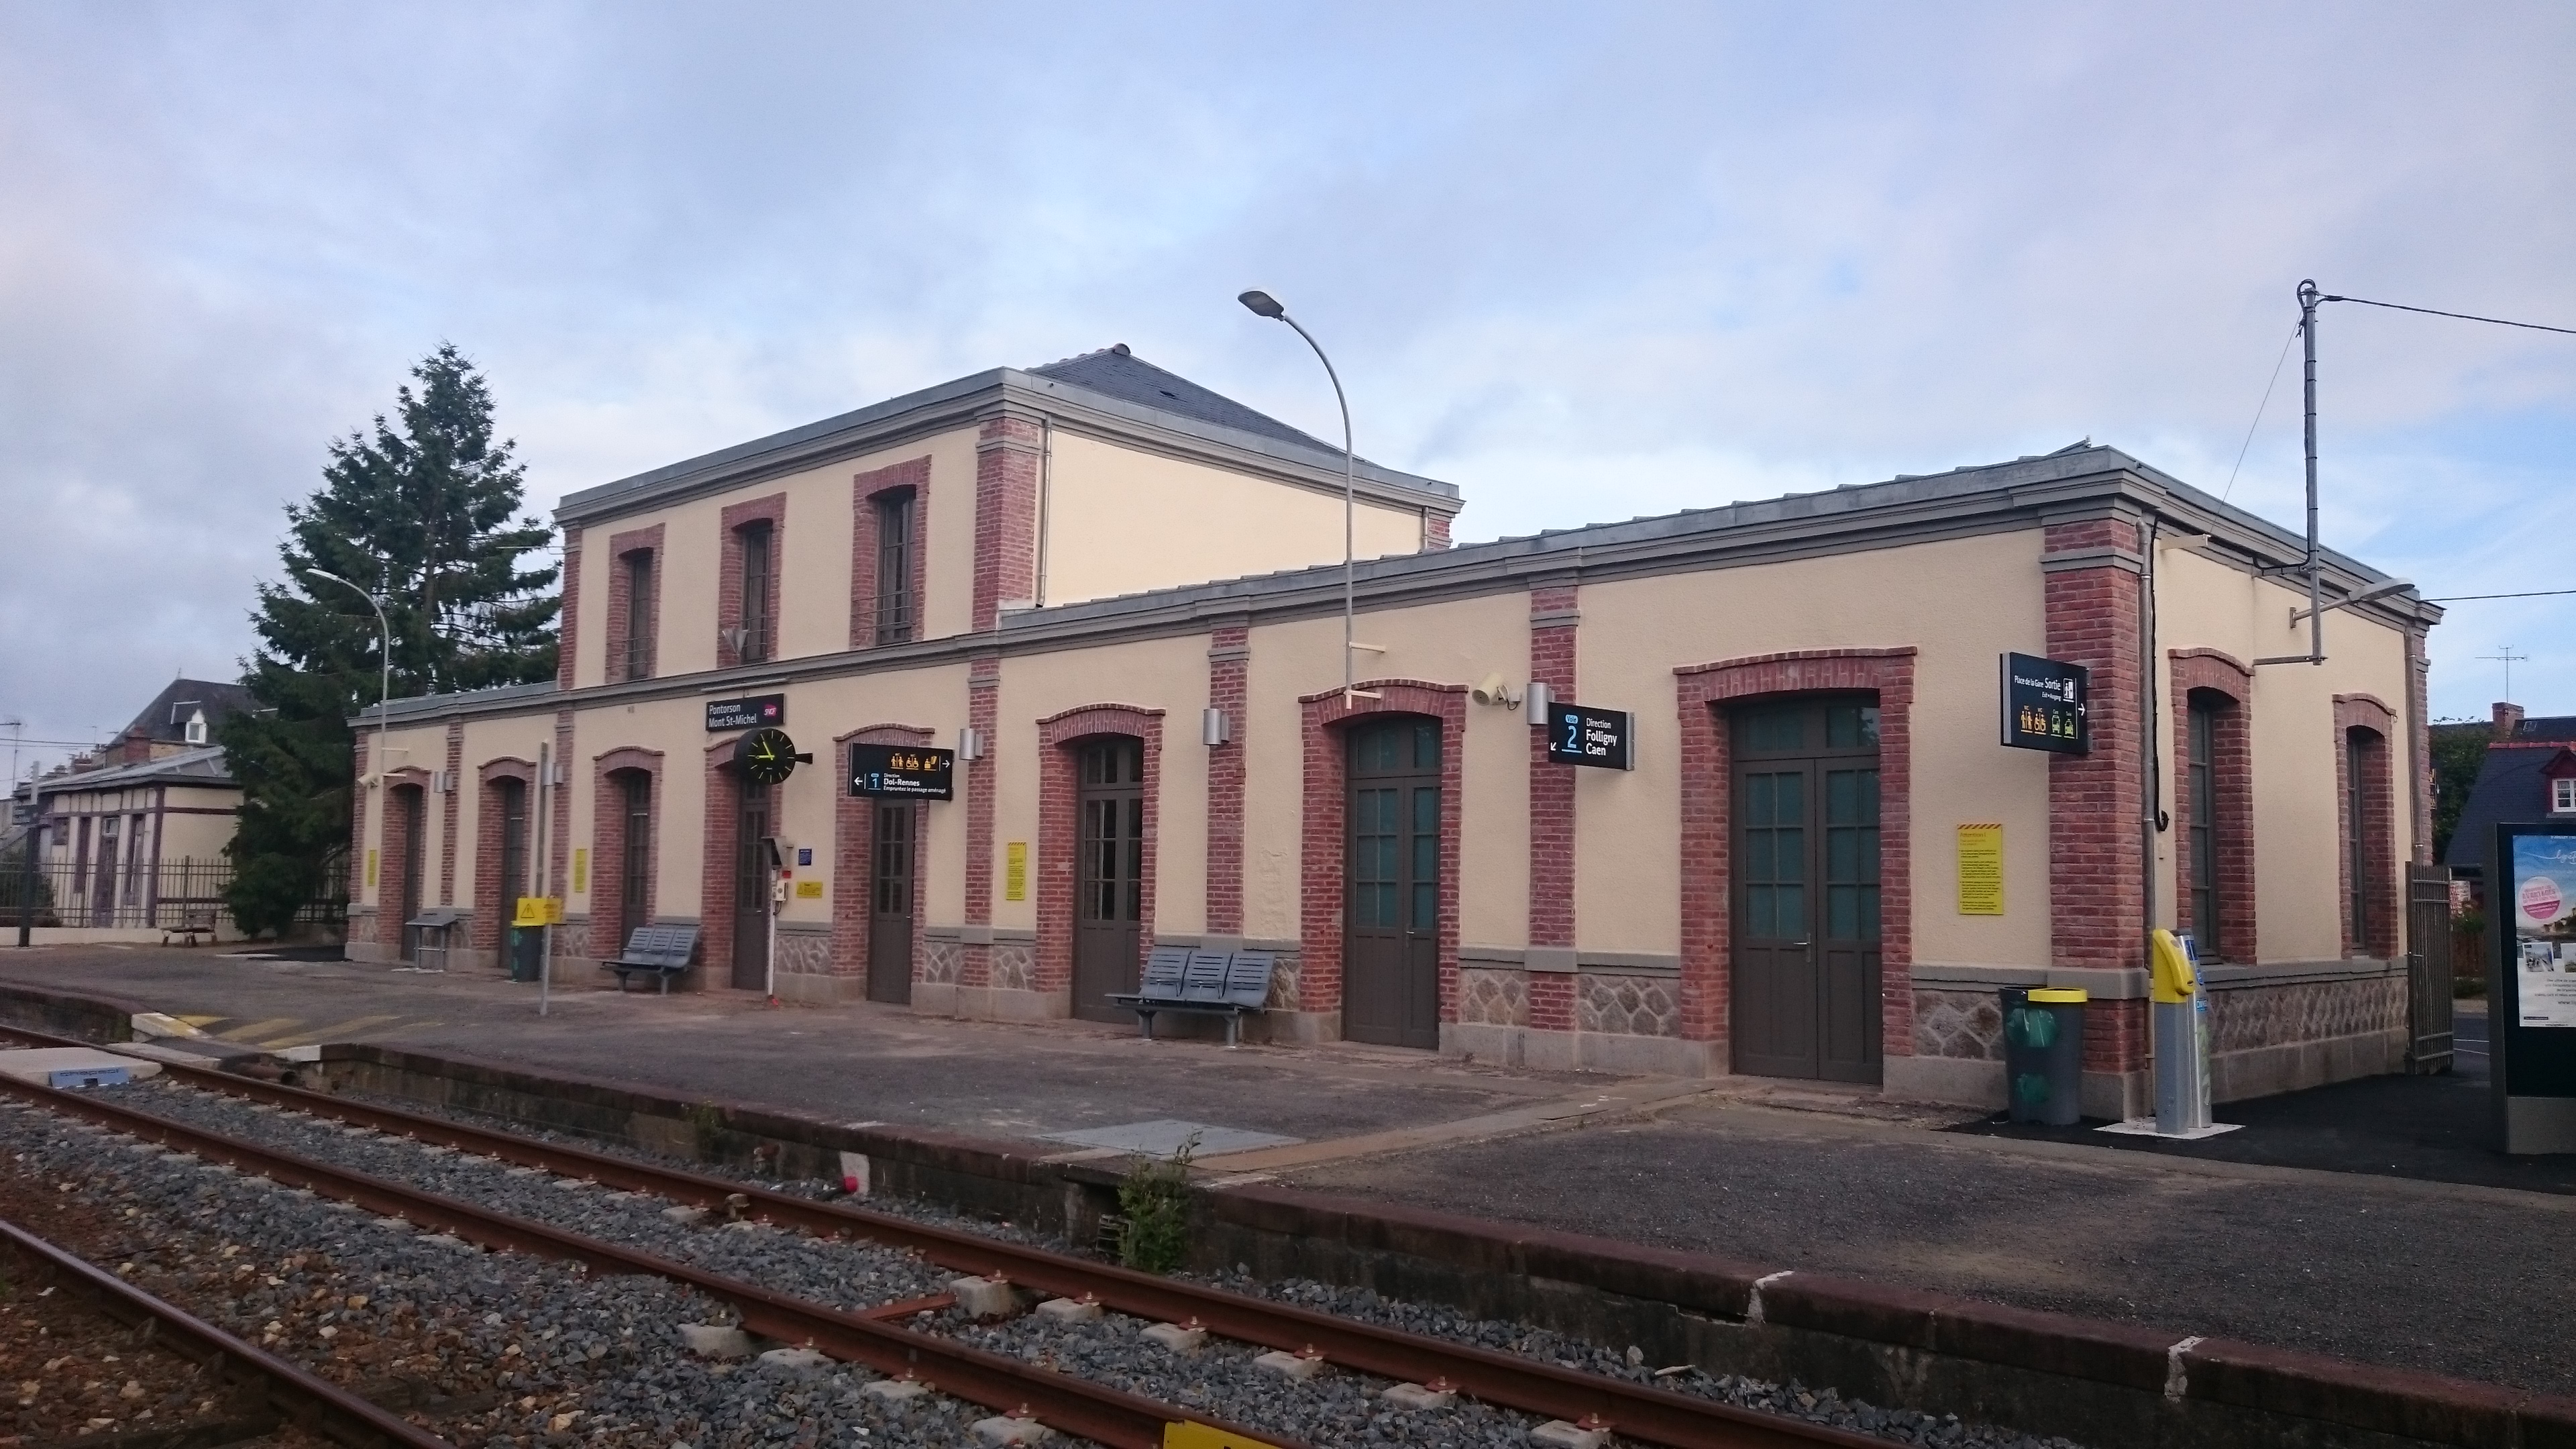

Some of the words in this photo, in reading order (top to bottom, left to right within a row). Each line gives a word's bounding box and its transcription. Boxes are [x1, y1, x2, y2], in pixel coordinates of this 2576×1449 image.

[2015, 675, 2025, 684] Place
[2025, 678, 2030, 686] de
[2031, 678, 2035, 686] la
[2035, 679, 2043, 688] Gare
[2045, 678, 2061, 690] Sortie
[709, 704, 741, 715] Pontorson
[763, 708, 777, 716] SNCF
[708, 718, 724, 727] Mont
[726, 713, 757, 726] St-Michel
[1586, 718, 1611, 729] Direction
[1567, 725, 1577, 749] 2
[1586, 729, 1617, 747] Folligny
[1586, 743, 1606, 755] Caen
[872, 778, 877, 788] 1
[883, 778, 920, 786] Dol-Rennes
